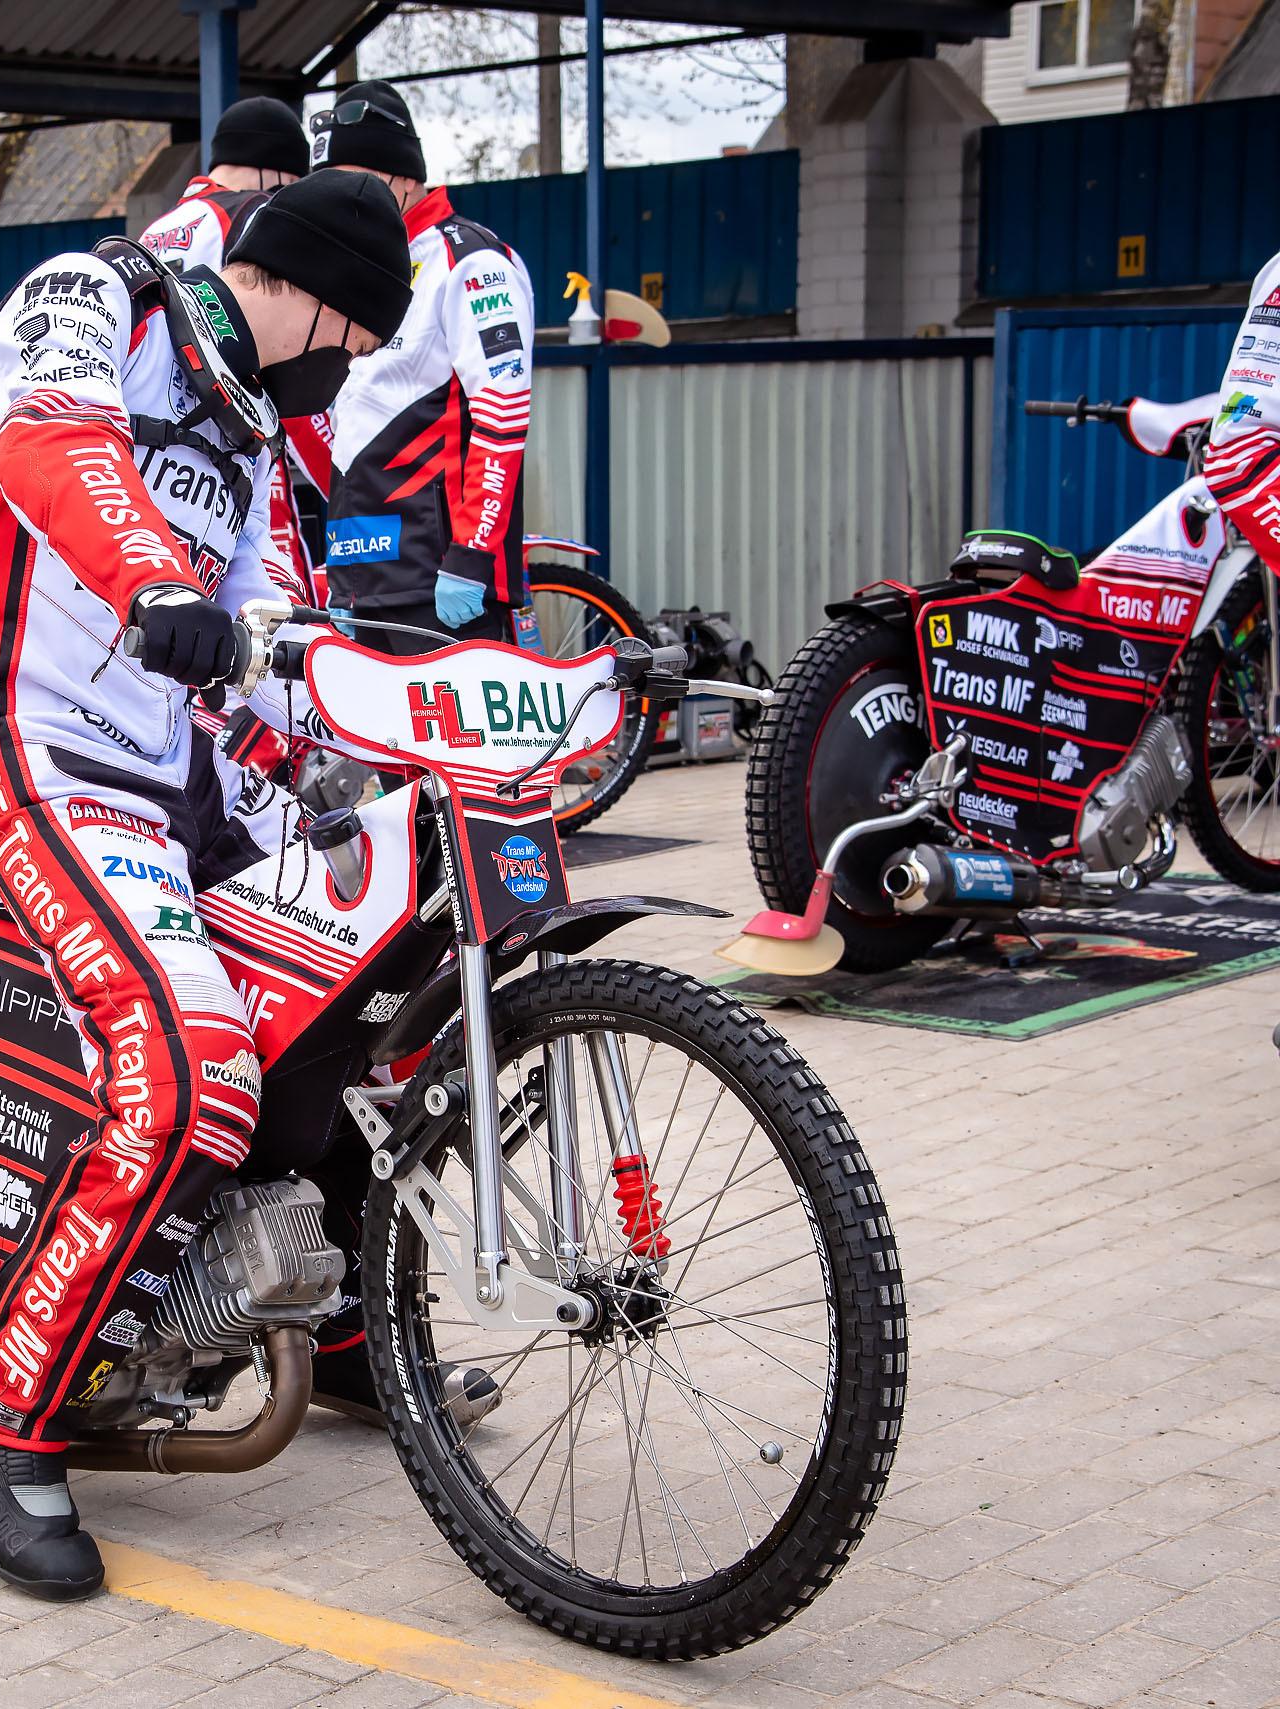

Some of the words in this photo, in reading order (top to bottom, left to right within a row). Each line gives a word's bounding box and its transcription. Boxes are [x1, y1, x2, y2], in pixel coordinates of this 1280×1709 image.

[111, 256, 154, 280] Tra
[1122, 245, 1141, 268] 11
[24, 272, 108, 306] WWK
[470, 292, 513, 315] WWK
[42, 296, 118, 332] SCHWAIGER
[66, 441, 141, 525] Trans
[484, 457, 507, 487] MF
[1098, 585, 1154, 622] Trans
[1155, 594, 1192, 626] MF
[956, 639, 983, 655] JOSEF
[966, 610, 1020, 653] WWK
[932, 656, 998, 706] Trans
[1001, 674, 1036, 714] MF
[411, 709, 443, 718] HEINRICH
[481, 681, 567, 735] BAU
[450, 736, 477, 745] LEHNER
[959, 791, 1019, 819] neudecker
[505, 845, 525, 856] Trans
[525, 845, 536, 856] MF
[490, 851, 551, 883] DEVILS
[511, 881, 545, 893] Landshut
[57, 921, 121, 985] MF
[587, 1014, 600, 1022] DOT
[110, 1001, 149, 1130] Trans
[9, 1192, 38, 1217] Eib
[23, 1204, 116, 1323] Trans
[386, 1217, 400, 1318] PLATINUM
[824, 1301, 838, 1416] PLATINUM
